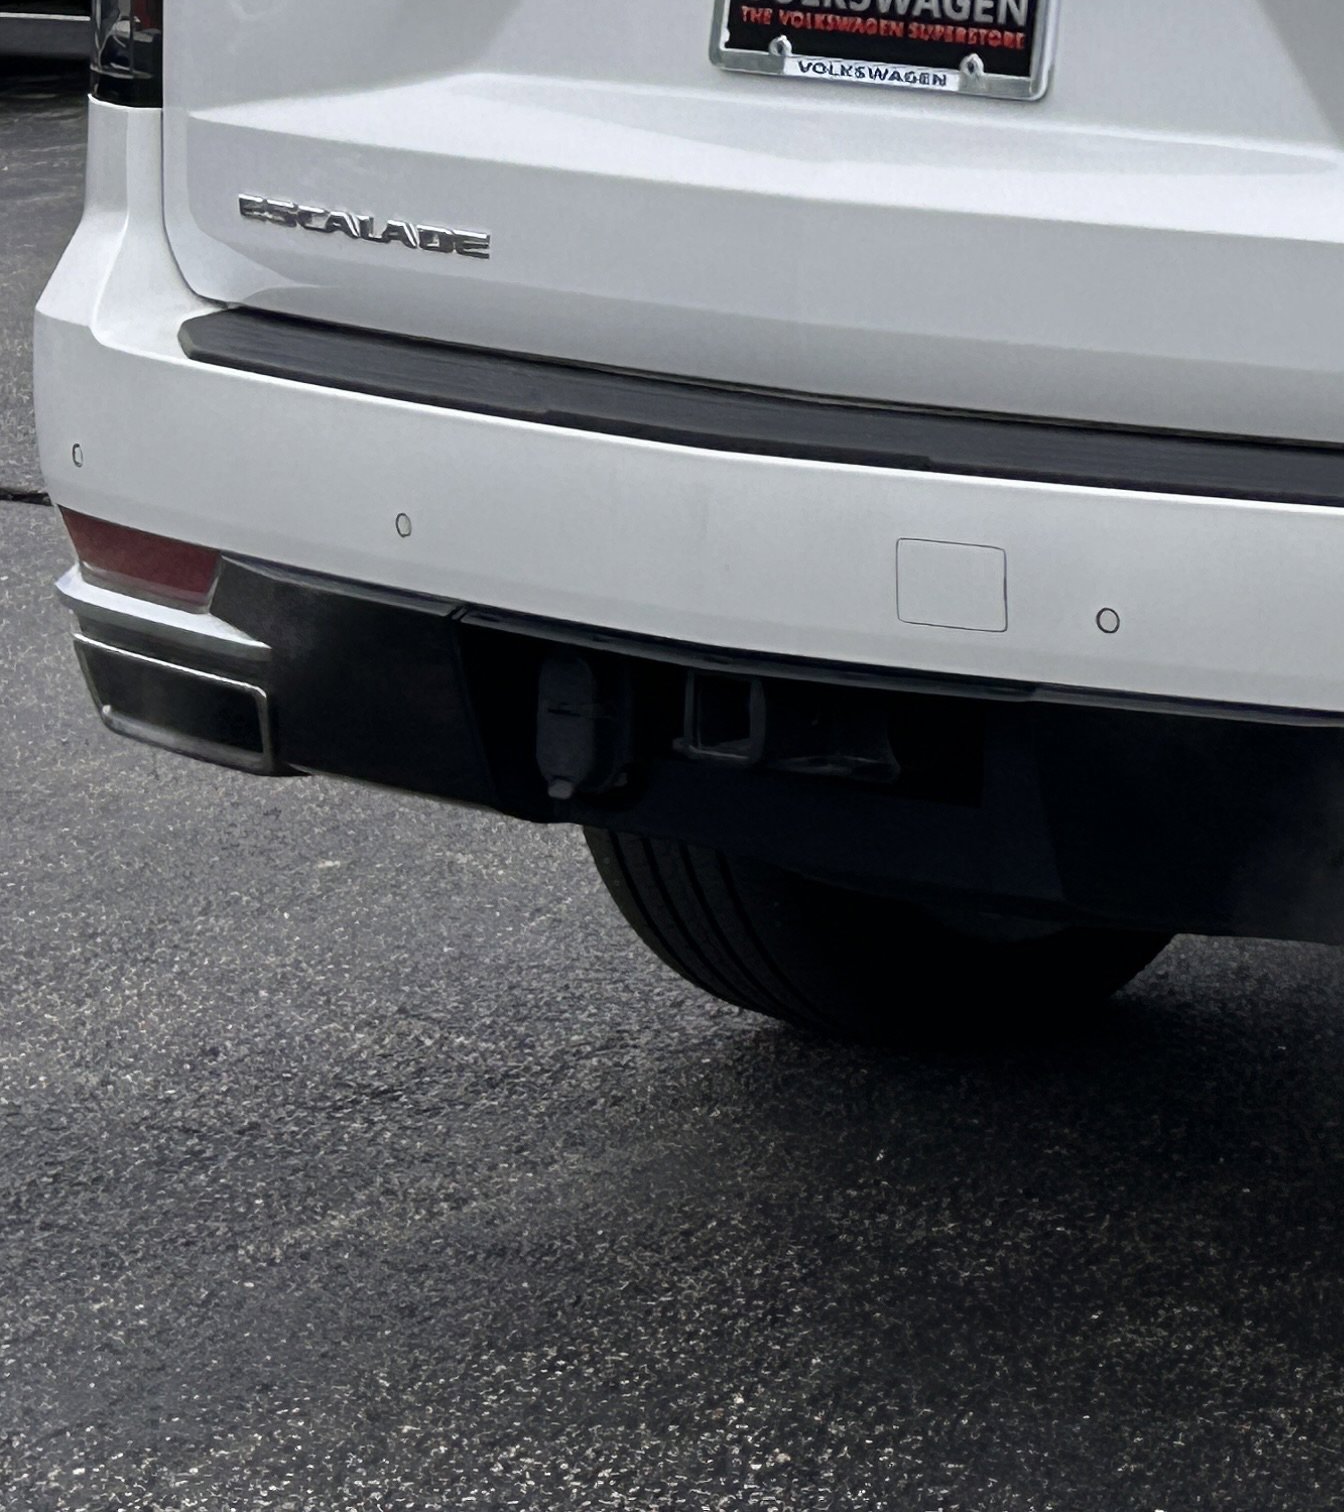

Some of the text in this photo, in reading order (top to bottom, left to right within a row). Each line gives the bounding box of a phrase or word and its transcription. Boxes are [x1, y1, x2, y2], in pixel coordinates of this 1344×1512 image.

[740, 5, 1026, 50] THE VOLKSWAGEN SUPERSTORE
[797, 60, 947, 88] VOLKSWAGEN
[237, 192, 492, 260] ESCALADE
